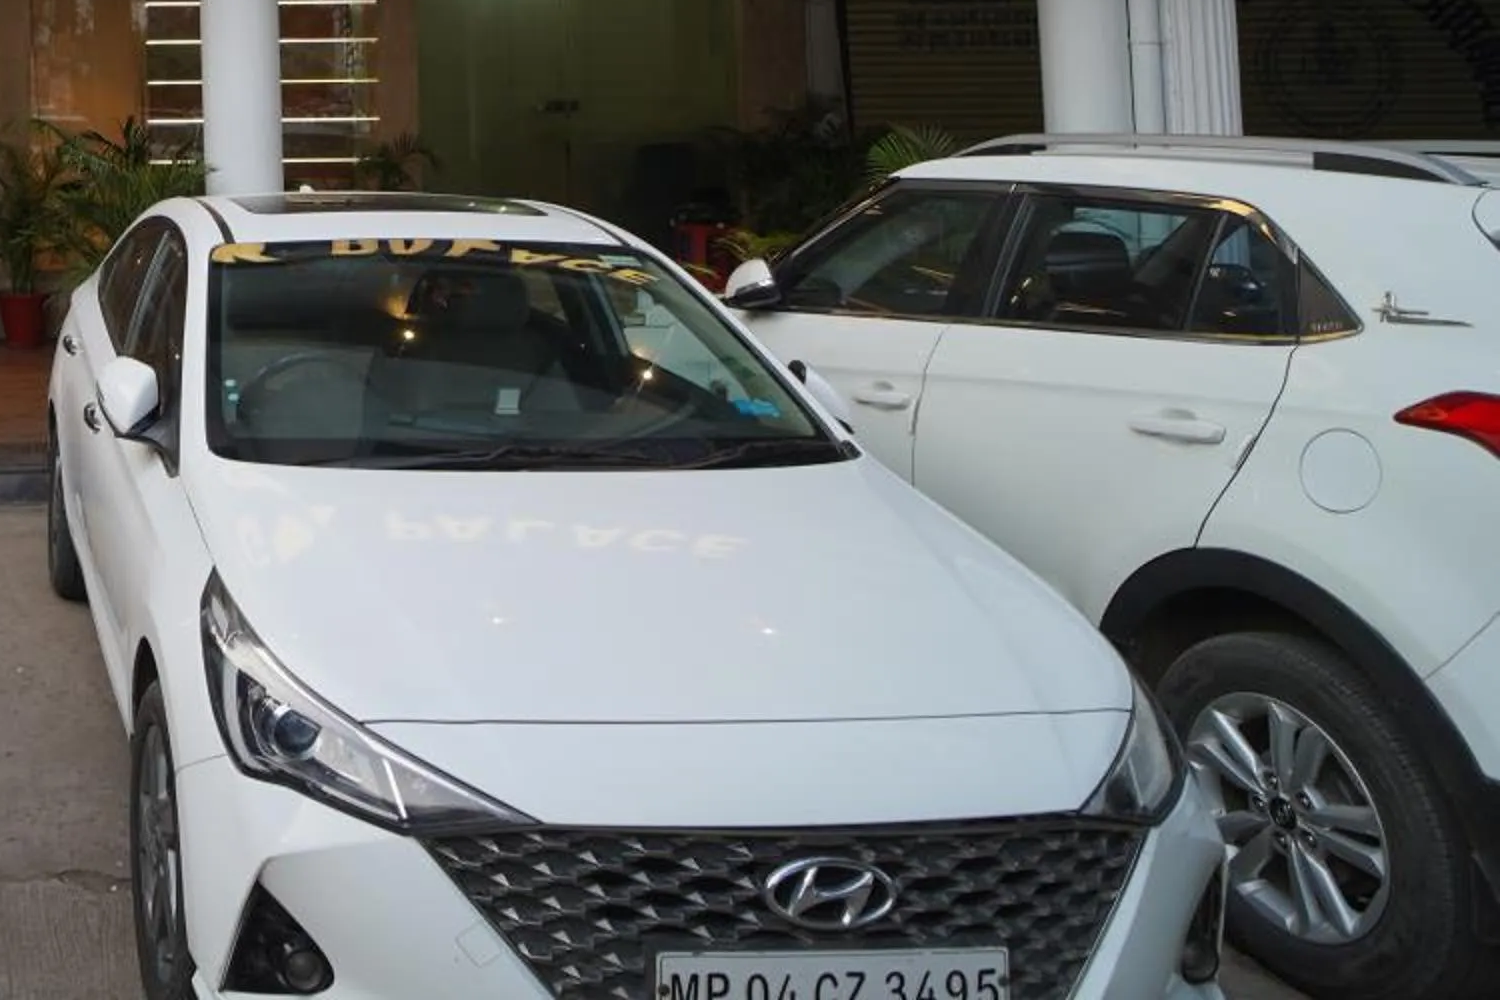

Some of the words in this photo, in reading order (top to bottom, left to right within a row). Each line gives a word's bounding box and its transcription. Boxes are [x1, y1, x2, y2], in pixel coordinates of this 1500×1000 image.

[670, 972, 730, 1000] MP
[746, 972, 796, 1000] 04
[814, 970, 866, 1000] CZ
[885, 968, 999, 1000] 3495
